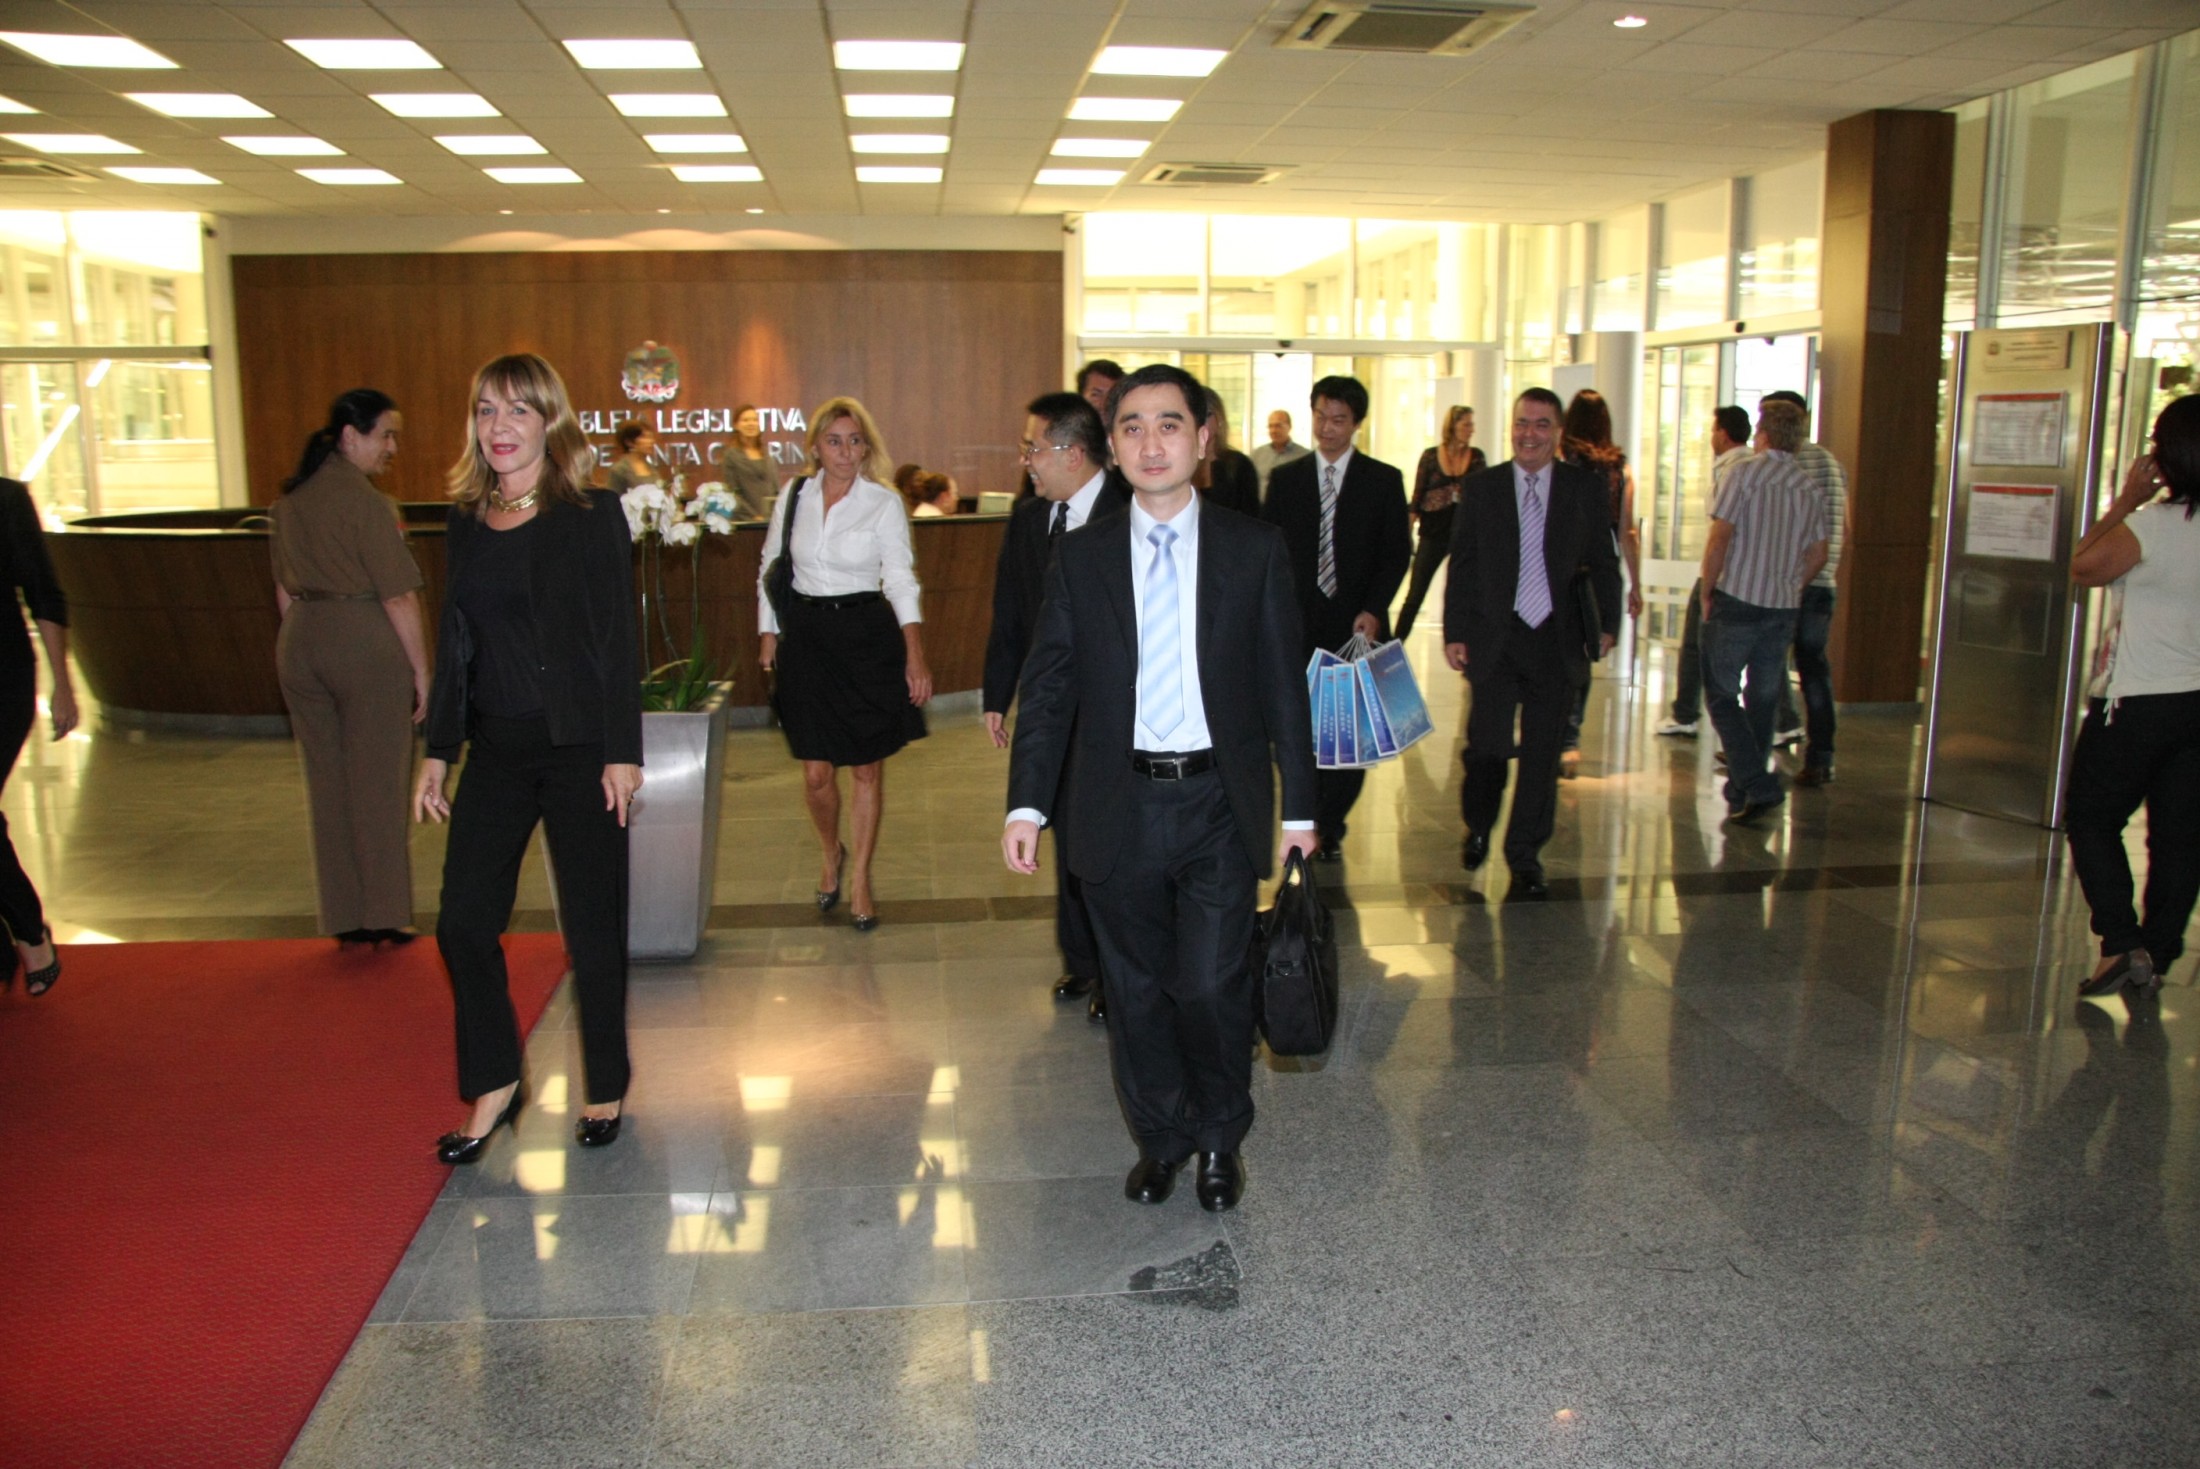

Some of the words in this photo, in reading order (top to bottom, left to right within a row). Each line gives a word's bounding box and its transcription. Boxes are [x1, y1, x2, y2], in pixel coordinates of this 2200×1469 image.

[656, 408, 806, 433] LEGISLTIVA
[646, 442, 701, 466] NTA
[707, 441, 806, 465] CRIN
